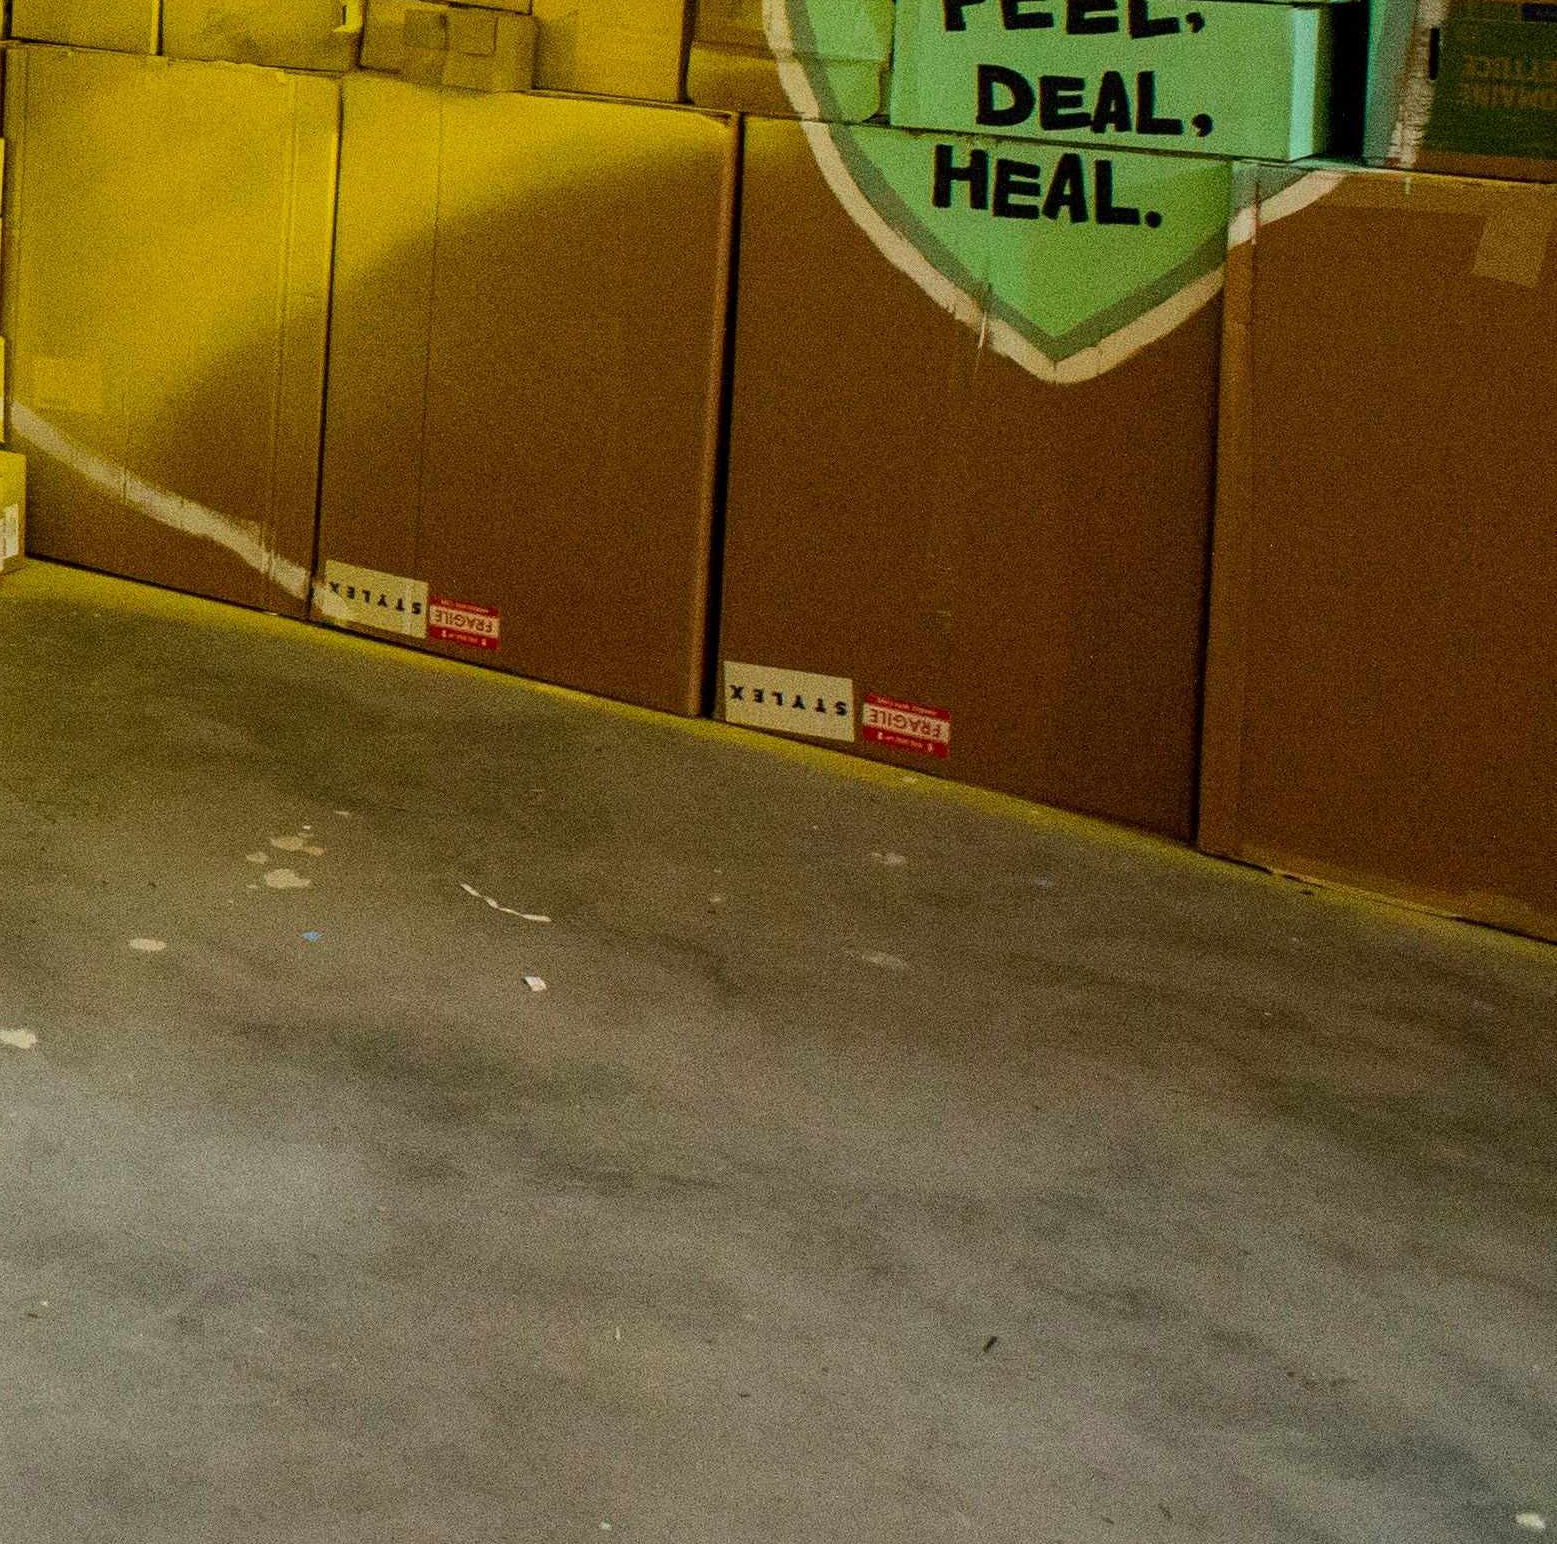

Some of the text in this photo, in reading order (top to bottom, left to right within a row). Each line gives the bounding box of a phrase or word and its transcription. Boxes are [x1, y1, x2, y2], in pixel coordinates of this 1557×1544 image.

[976, 63, 1214, 137] DEAL,
[932, 143, 1163, 229] HEAL.
[436, 610, 493, 634] FRAGILE
[729, 684, 848, 716] STYLEX
[869, 707, 942, 738] FRAGILE
